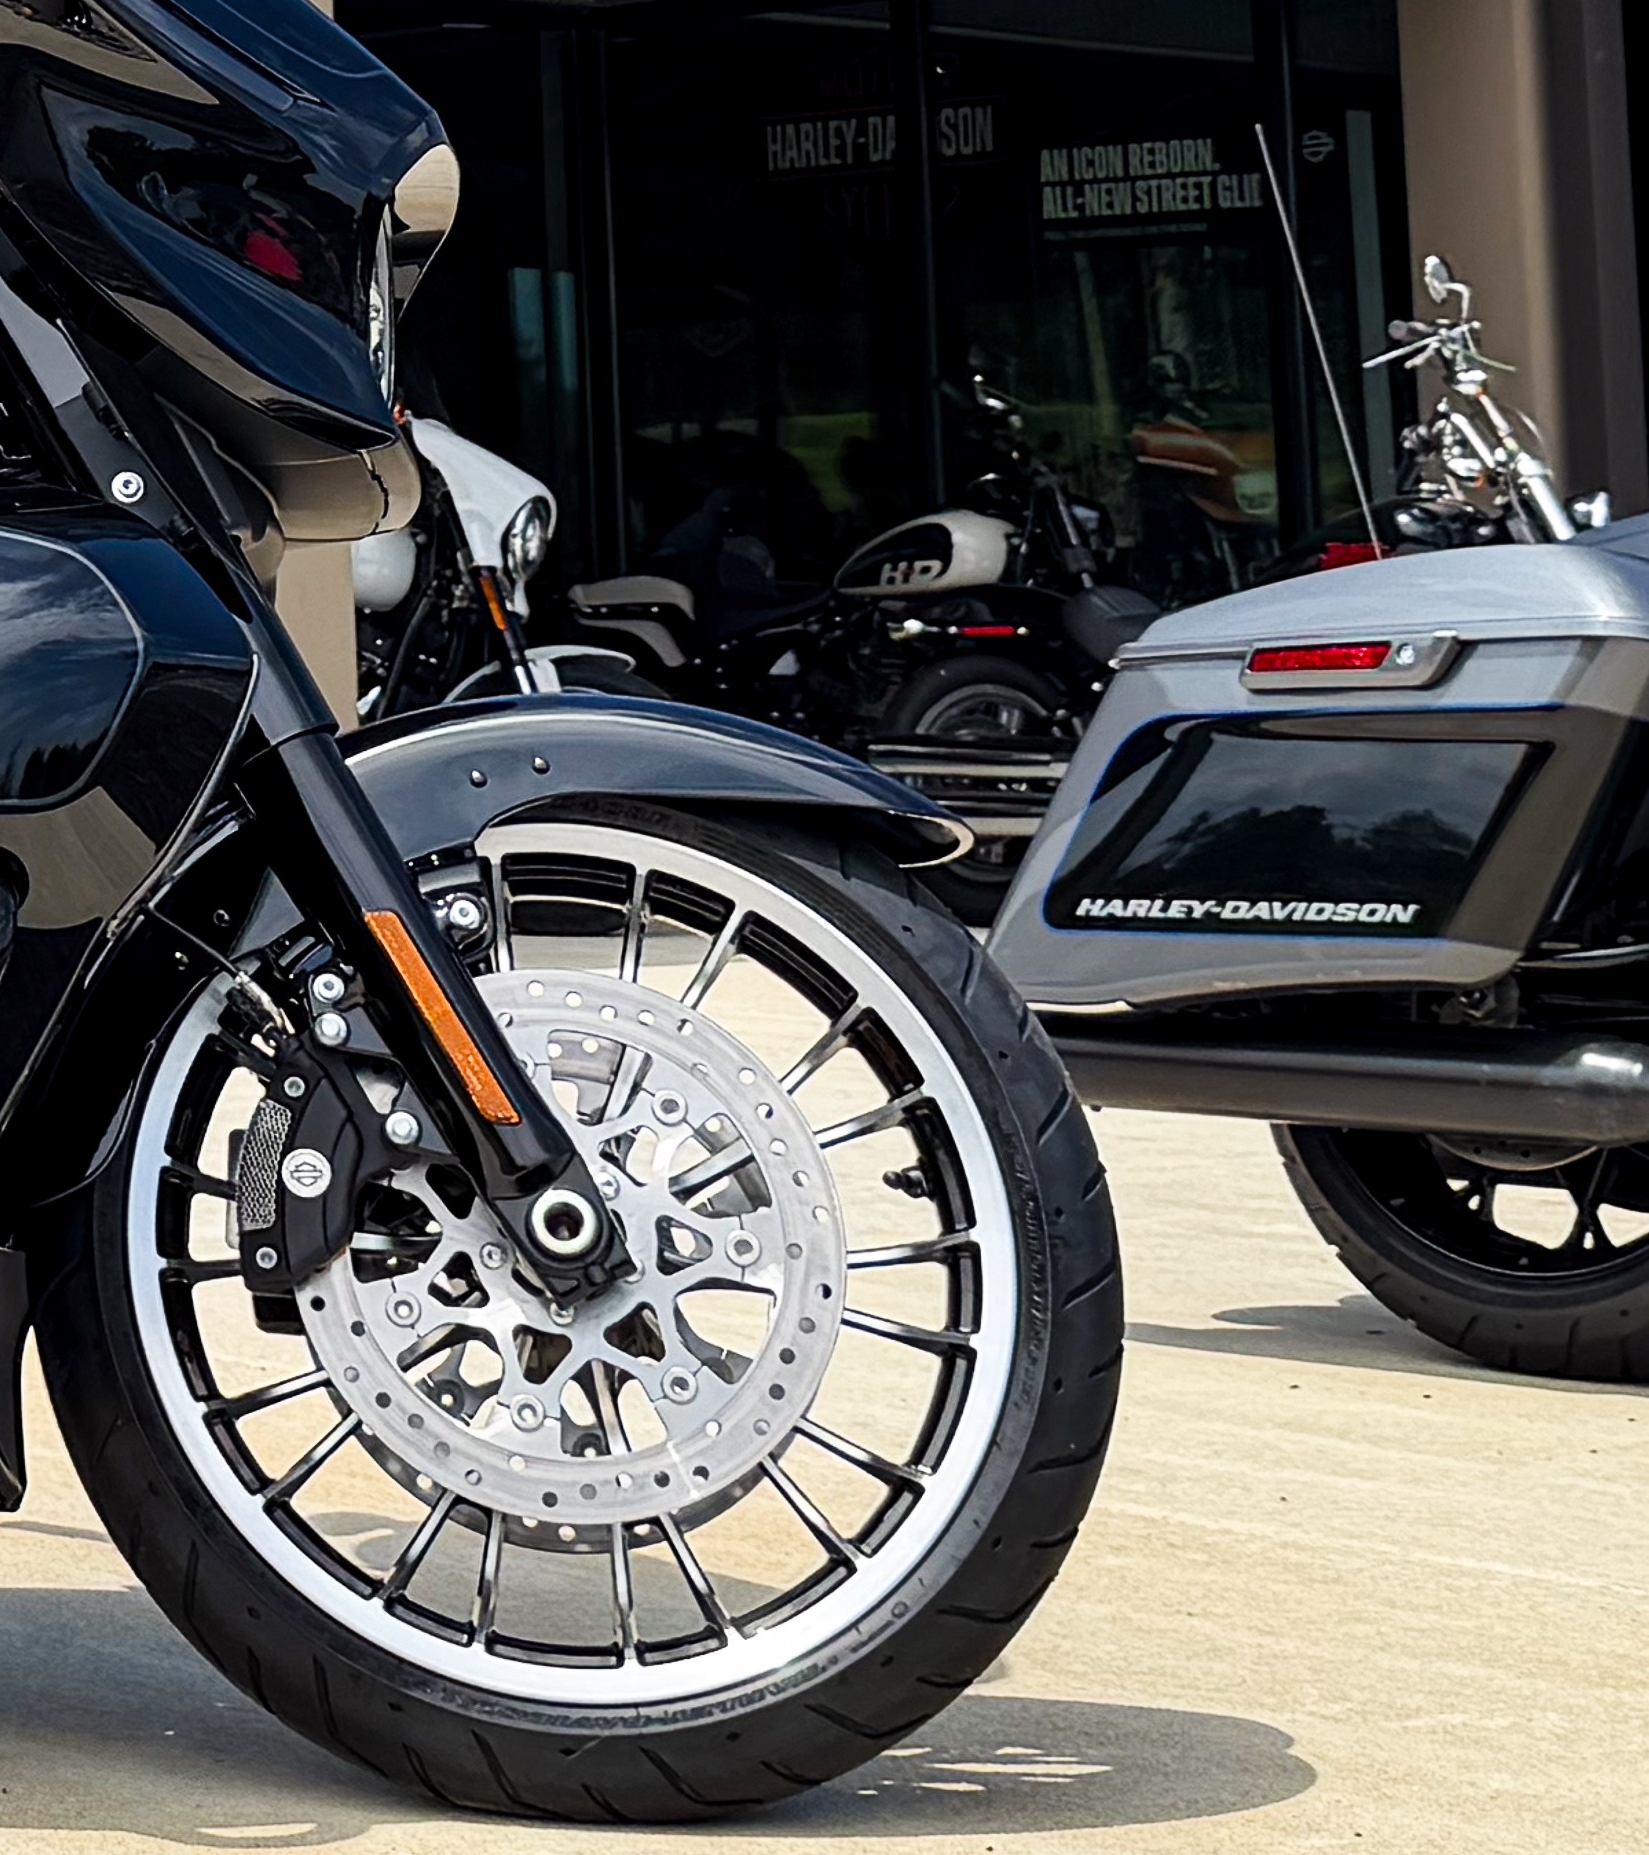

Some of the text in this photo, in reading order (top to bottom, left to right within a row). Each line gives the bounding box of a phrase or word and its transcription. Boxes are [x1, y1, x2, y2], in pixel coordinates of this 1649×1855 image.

[1040, 137, 1222, 183] AN ICON REBORN.
[1042, 180, 1133, 220] ALL-NEW
[1134, 175, 1214, 214] STREET
[1074, 897, 1422, 924] HARLEY-DAVIDSON
